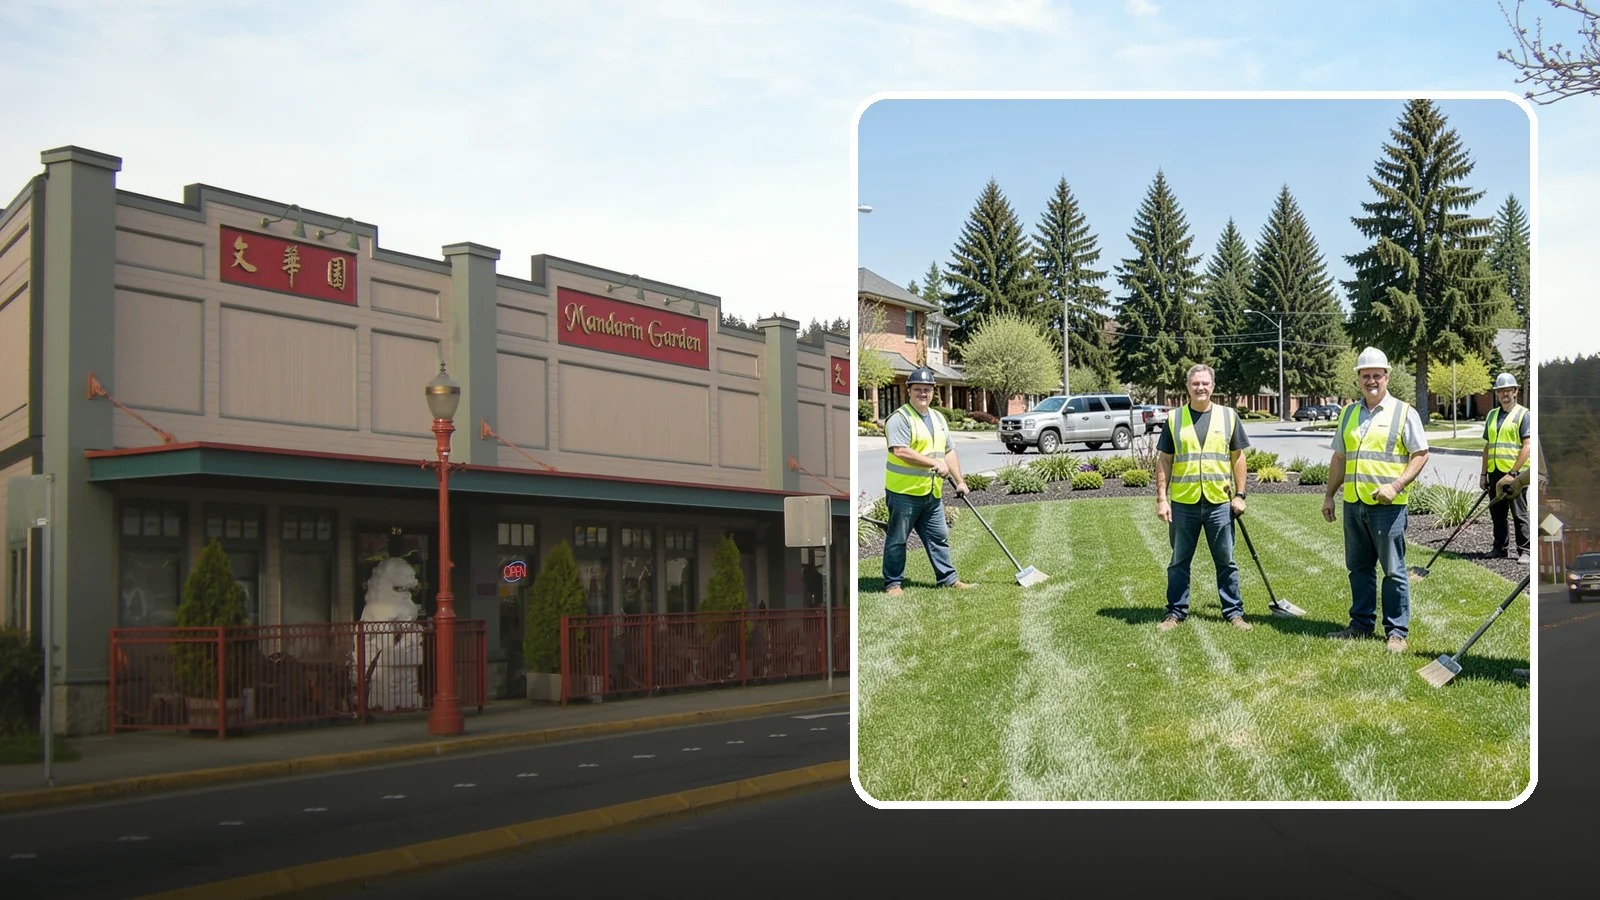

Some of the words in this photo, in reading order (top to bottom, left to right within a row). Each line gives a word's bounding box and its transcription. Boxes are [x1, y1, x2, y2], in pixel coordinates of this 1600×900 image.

[230, 235, 346, 291] 文華園
[564, 302, 644, 341] Mandarin
[648, 320, 702, 352] Garden
[503, 565, 527, 578] OPEN
